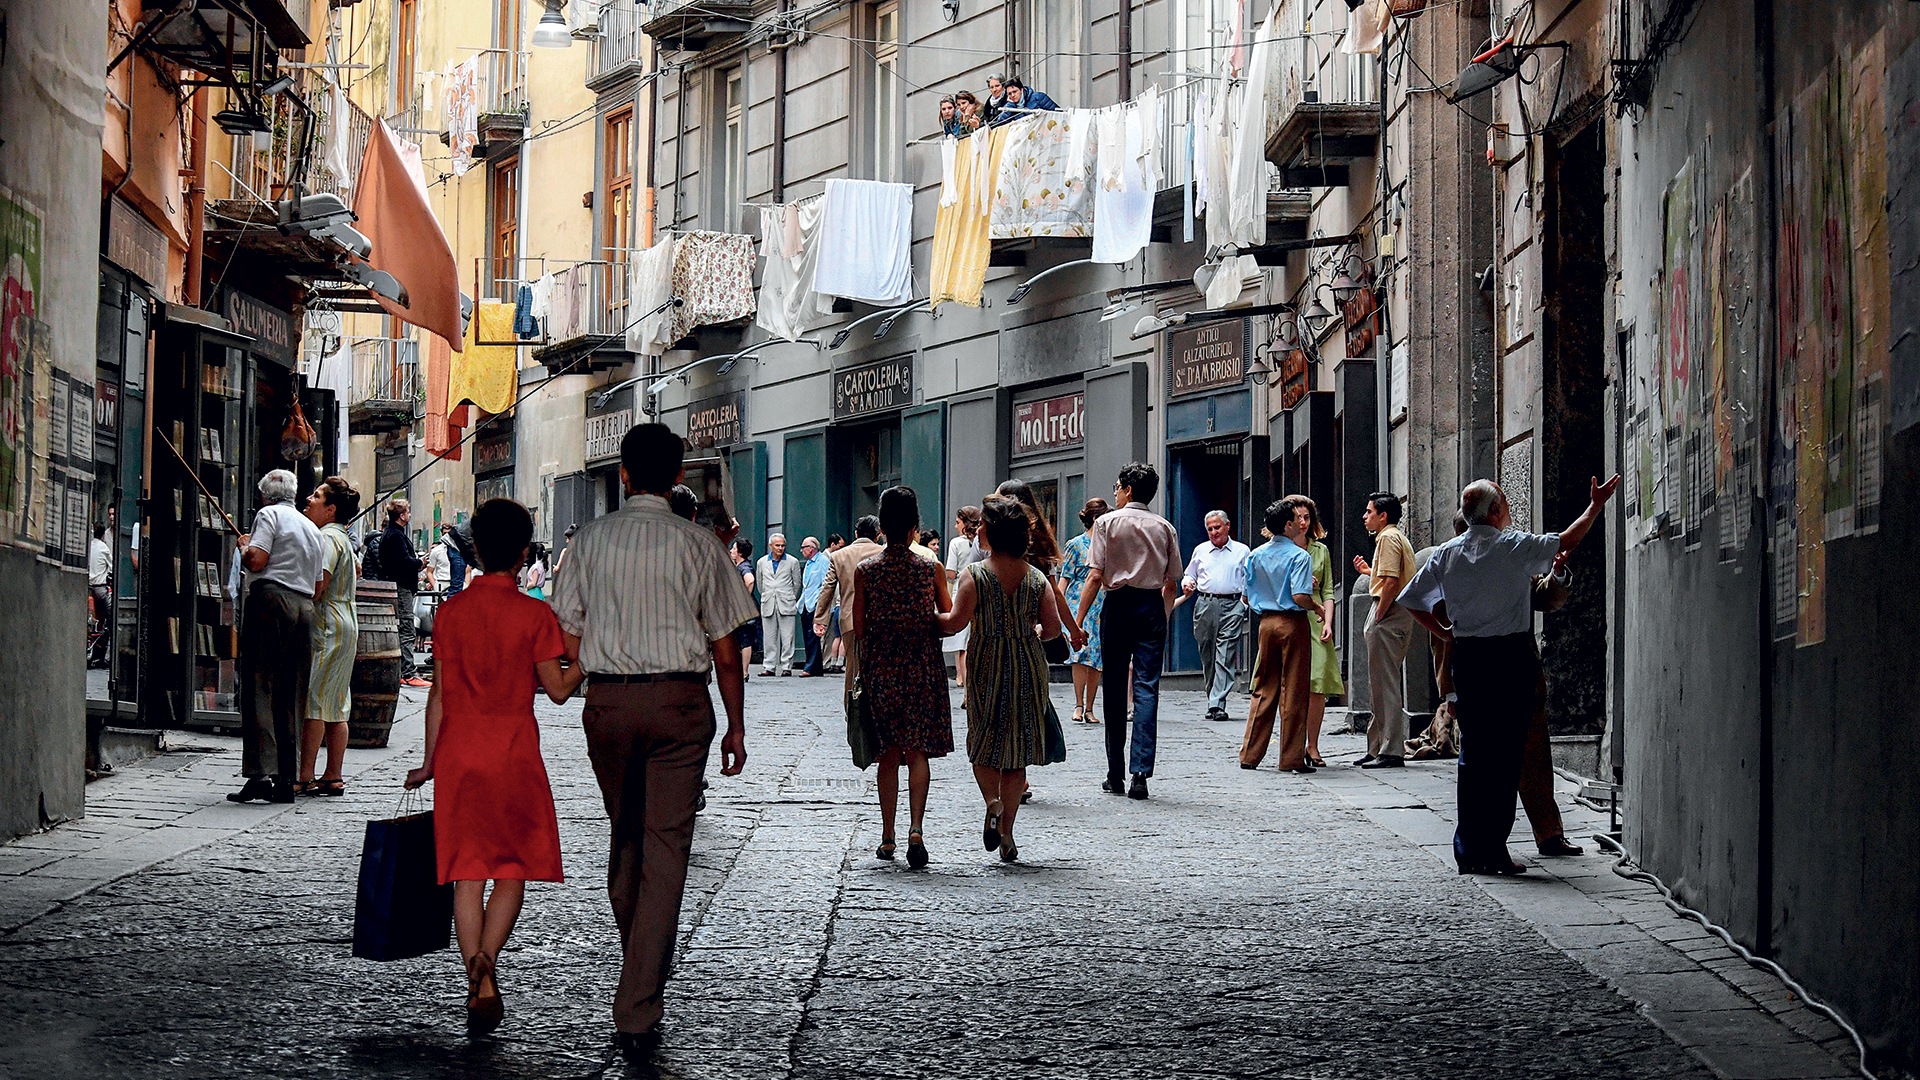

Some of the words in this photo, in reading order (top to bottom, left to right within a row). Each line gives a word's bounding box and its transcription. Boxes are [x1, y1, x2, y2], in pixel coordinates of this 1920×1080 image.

[229, 291, 289, 348] SALUMERIA
[1196, 327, 1220, 345] ANTICO
[1183, 341, 1233, 364] CALZATURIFICIO
[844, 363, 901, 396] CARTOLERIA
[1187, 357, 1241, 386] D'AMBROSIO
[859, 388, 893, 412] AMODIO
[586, 413, 630, 441] LIBRERIA
[690, 403, 738, 431] CARTOLERIA
[589, 440, 601, 458] DEL
[602, 435, 624, 454] CORS
